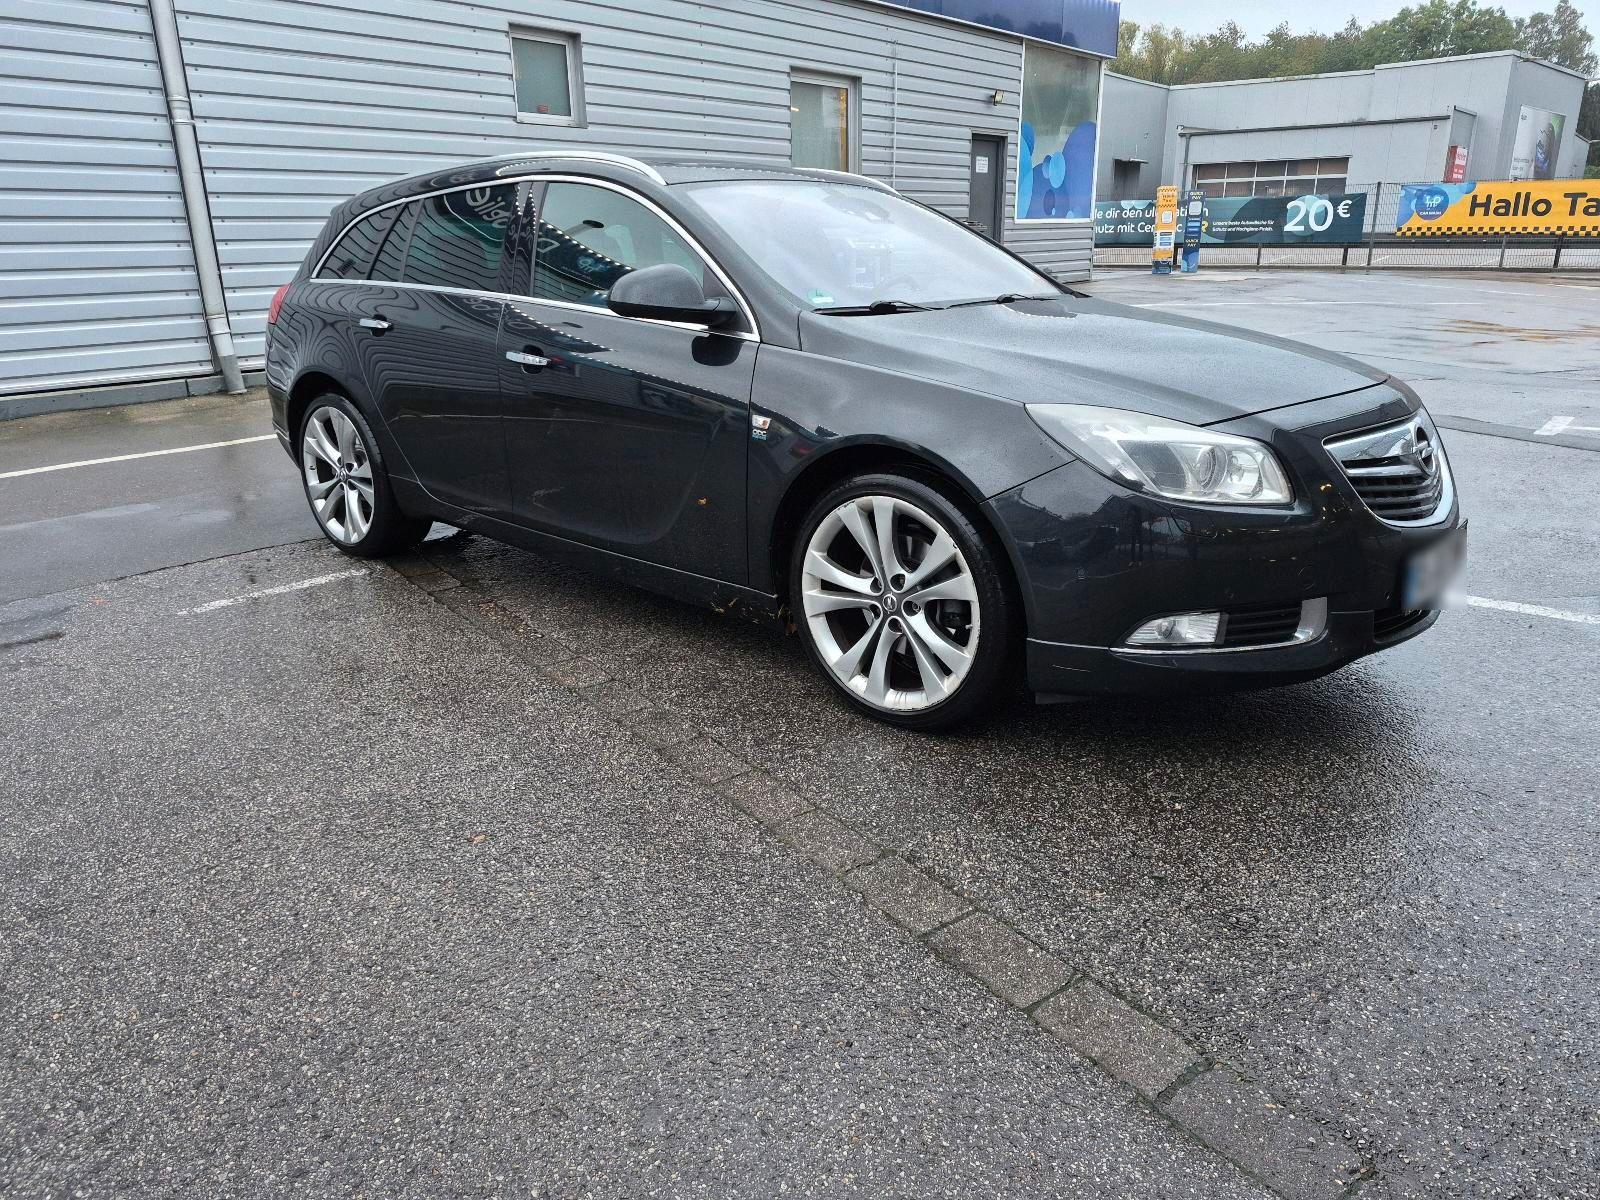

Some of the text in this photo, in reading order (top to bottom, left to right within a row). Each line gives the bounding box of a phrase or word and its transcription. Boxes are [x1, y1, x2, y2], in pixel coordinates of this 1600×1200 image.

[1469, 191, 1600, 217] Hallo Ta
[1105, 207, 1120, 219] dir
[1122, 208, 1143, 219] den
[1117, 222, 1135, 233] mit
